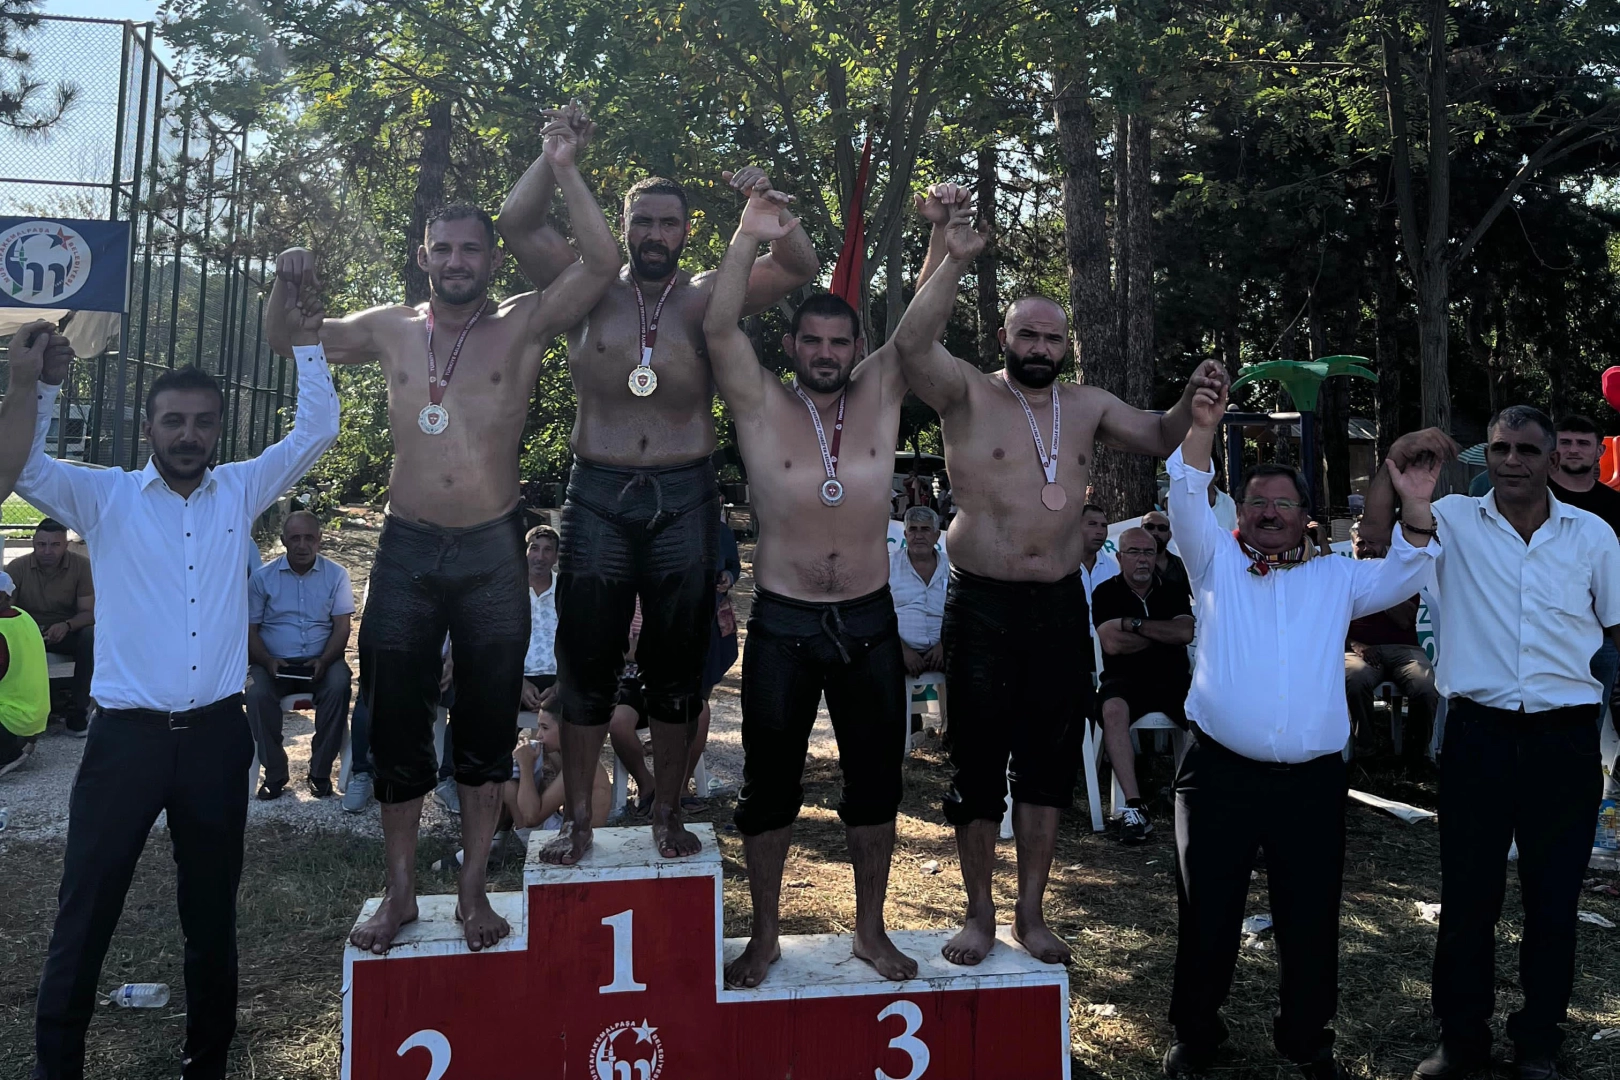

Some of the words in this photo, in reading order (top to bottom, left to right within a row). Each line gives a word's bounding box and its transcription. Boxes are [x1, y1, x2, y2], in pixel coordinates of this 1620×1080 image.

[599, 909, 646, 993] 1
[396, 1029, 451, 1080] 2
[589, 1020, 636, 1080] USTAFAKEMALPAŞA
[651, 1033, 664, 1080] BELEDİYES
[874, 1000, 930, 1080] 3
